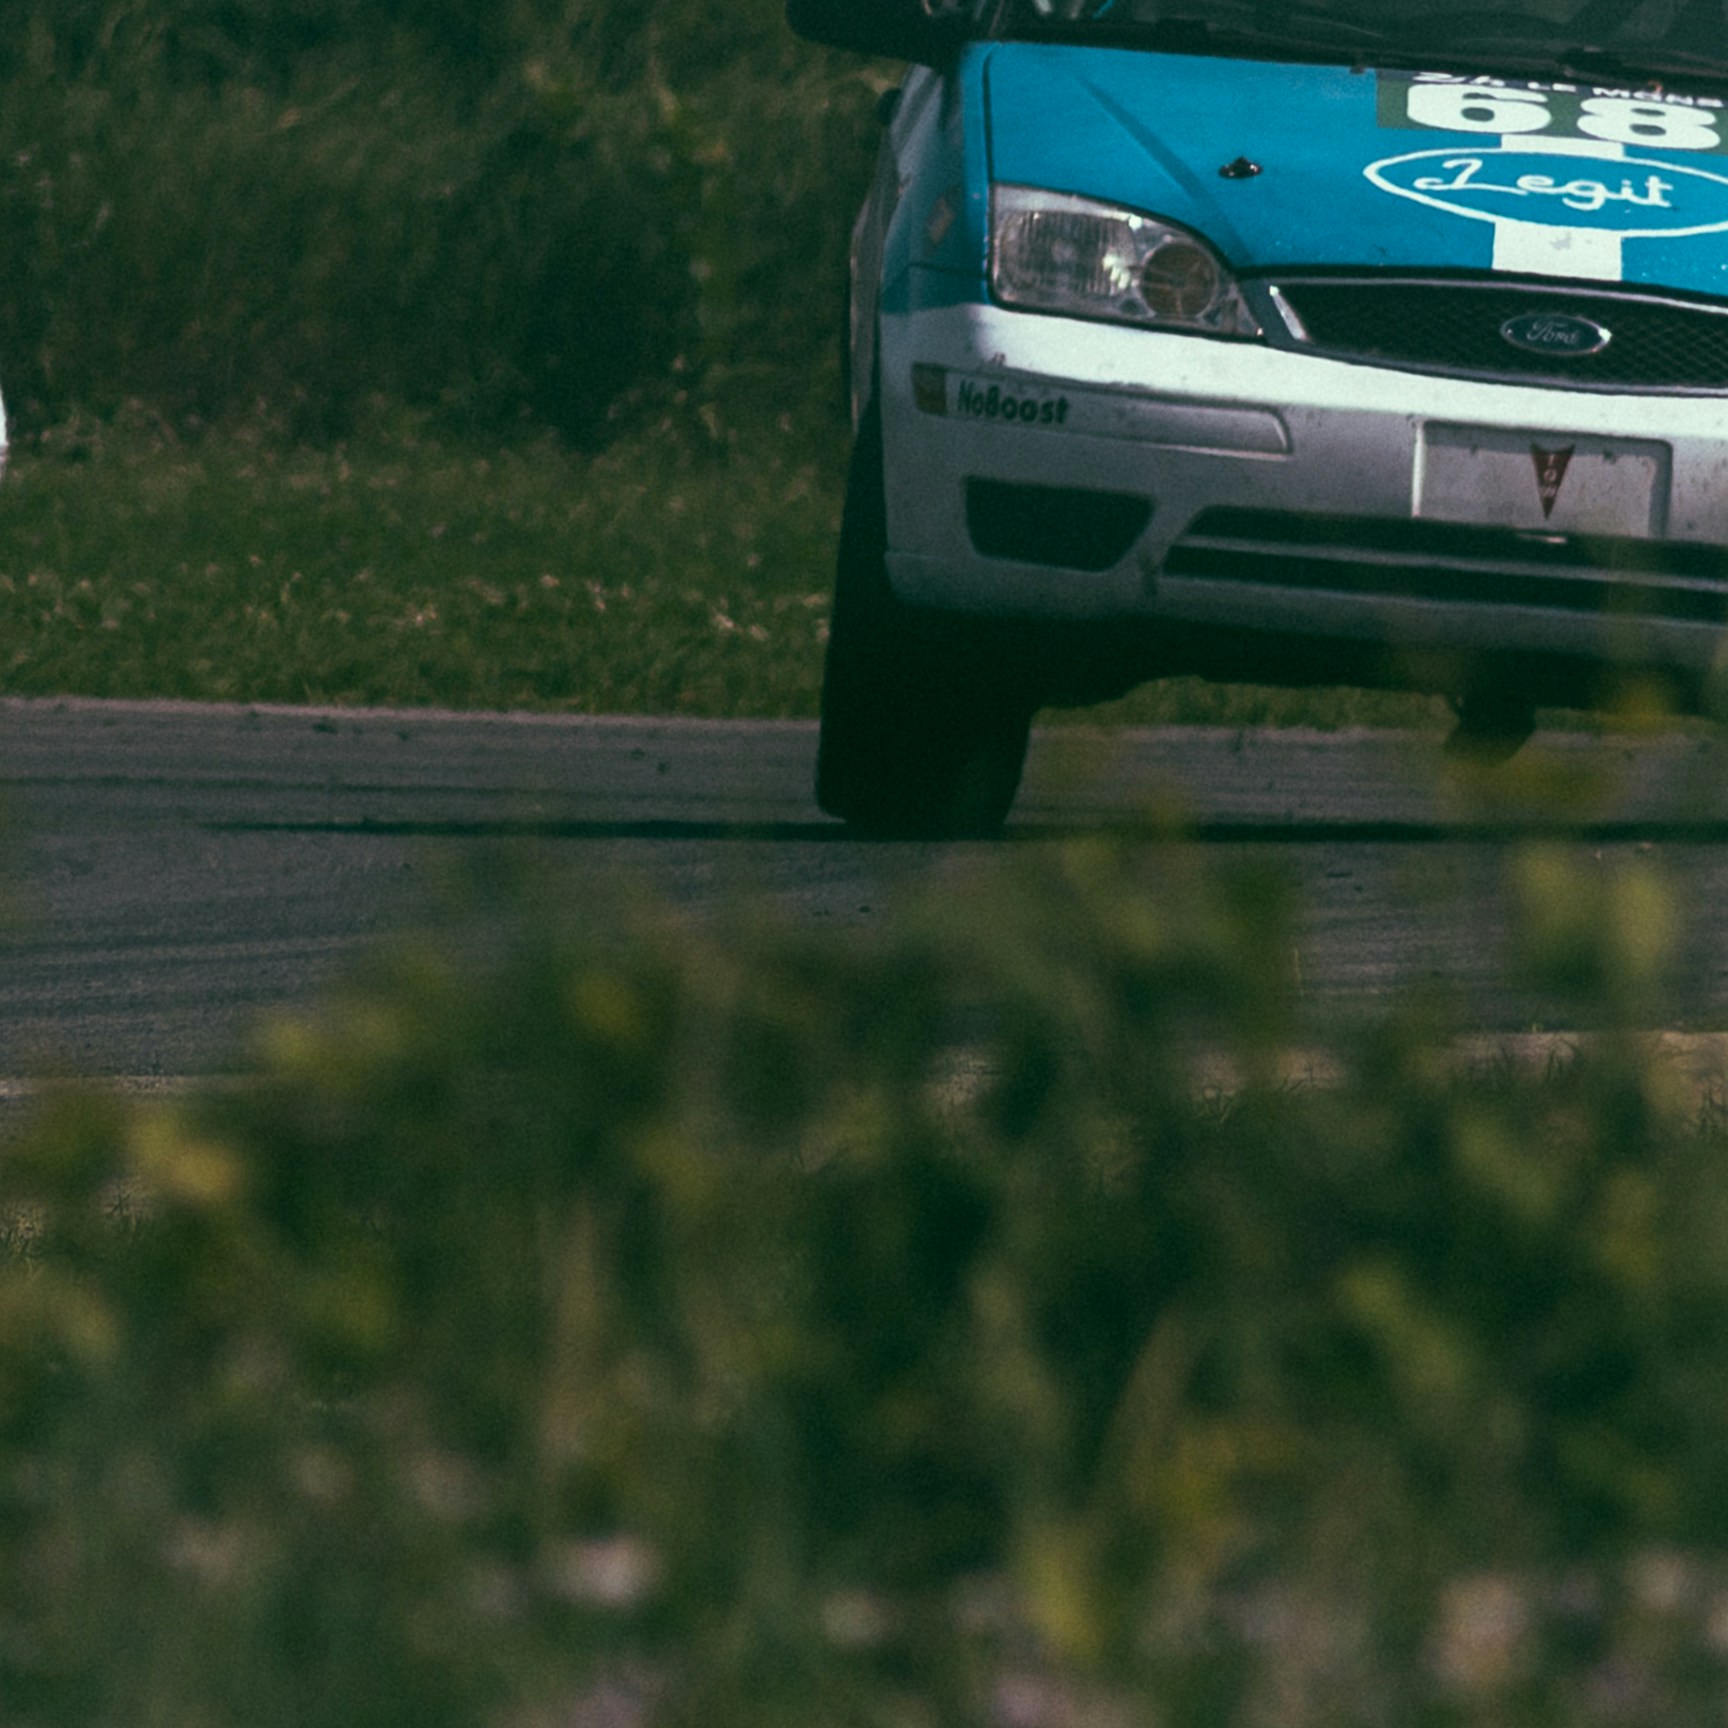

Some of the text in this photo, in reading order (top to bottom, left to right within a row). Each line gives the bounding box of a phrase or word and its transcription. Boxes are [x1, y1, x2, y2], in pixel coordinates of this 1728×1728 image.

[1407, 83, 1721, 150] 68
[1413, 158, 1674, 211] Legit
[1526, 321, 1579, 344] Ford
[958, 379, 1068, 424] NoBoost
